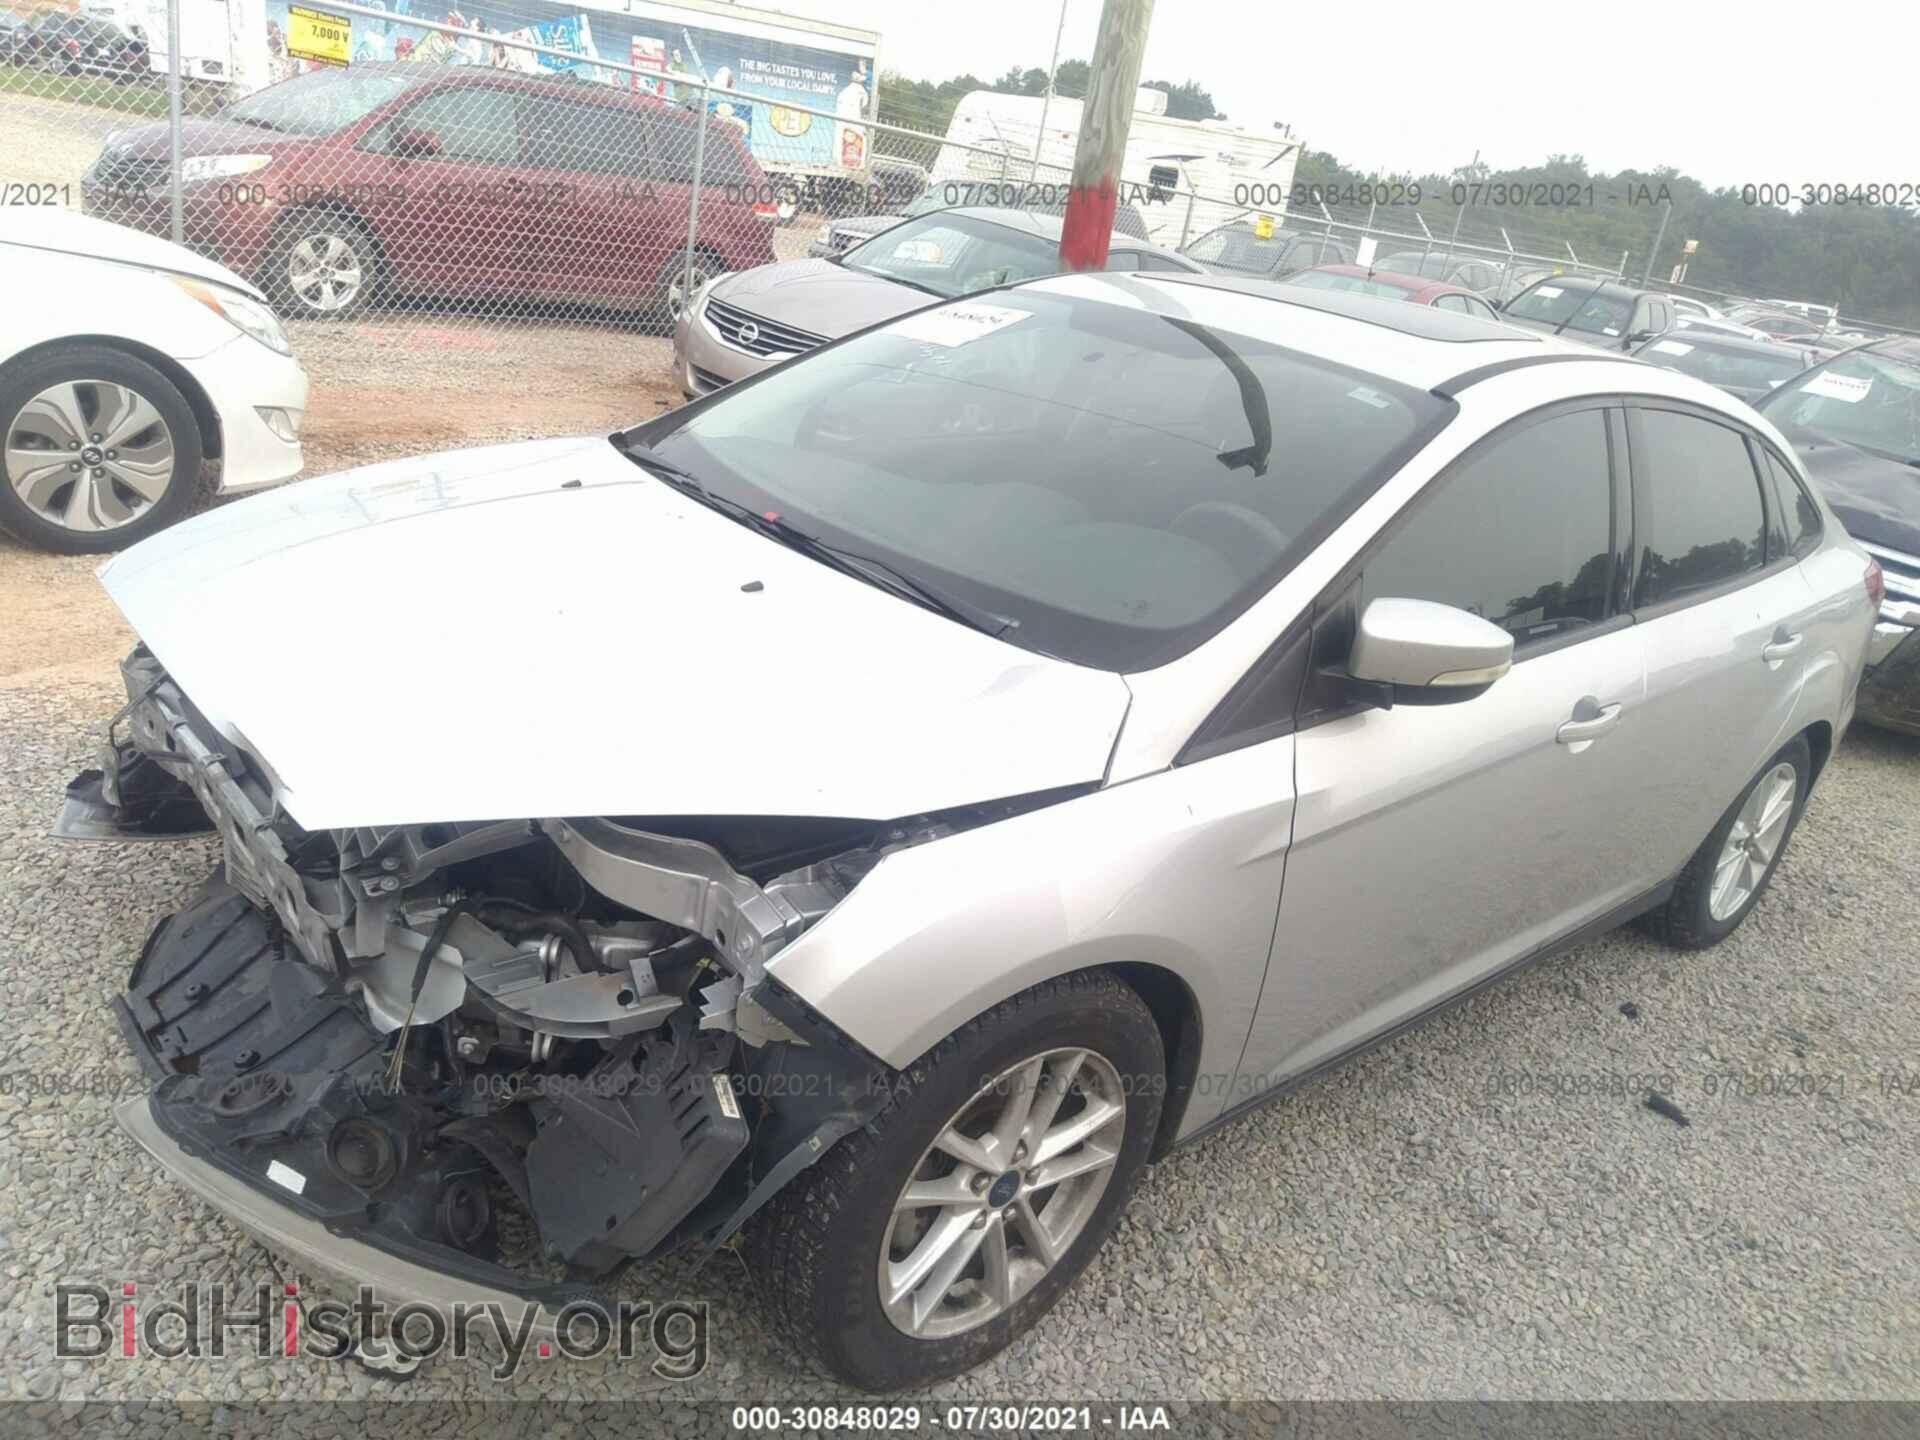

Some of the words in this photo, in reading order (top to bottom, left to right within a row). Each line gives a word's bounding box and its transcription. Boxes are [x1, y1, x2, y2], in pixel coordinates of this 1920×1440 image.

[312, 25, 340, 41] 7,000
[740, 58, 755, 71] THE
[756, 60, 772, 73] BIG
[772, 62, 800, 77] TASTES
[801, 67, 817, 80] YOU
[740, 72, 765, 84] FROM
[765, 74, 787, 88] YOUR
[787, 77, 810, 90] LOCAL
